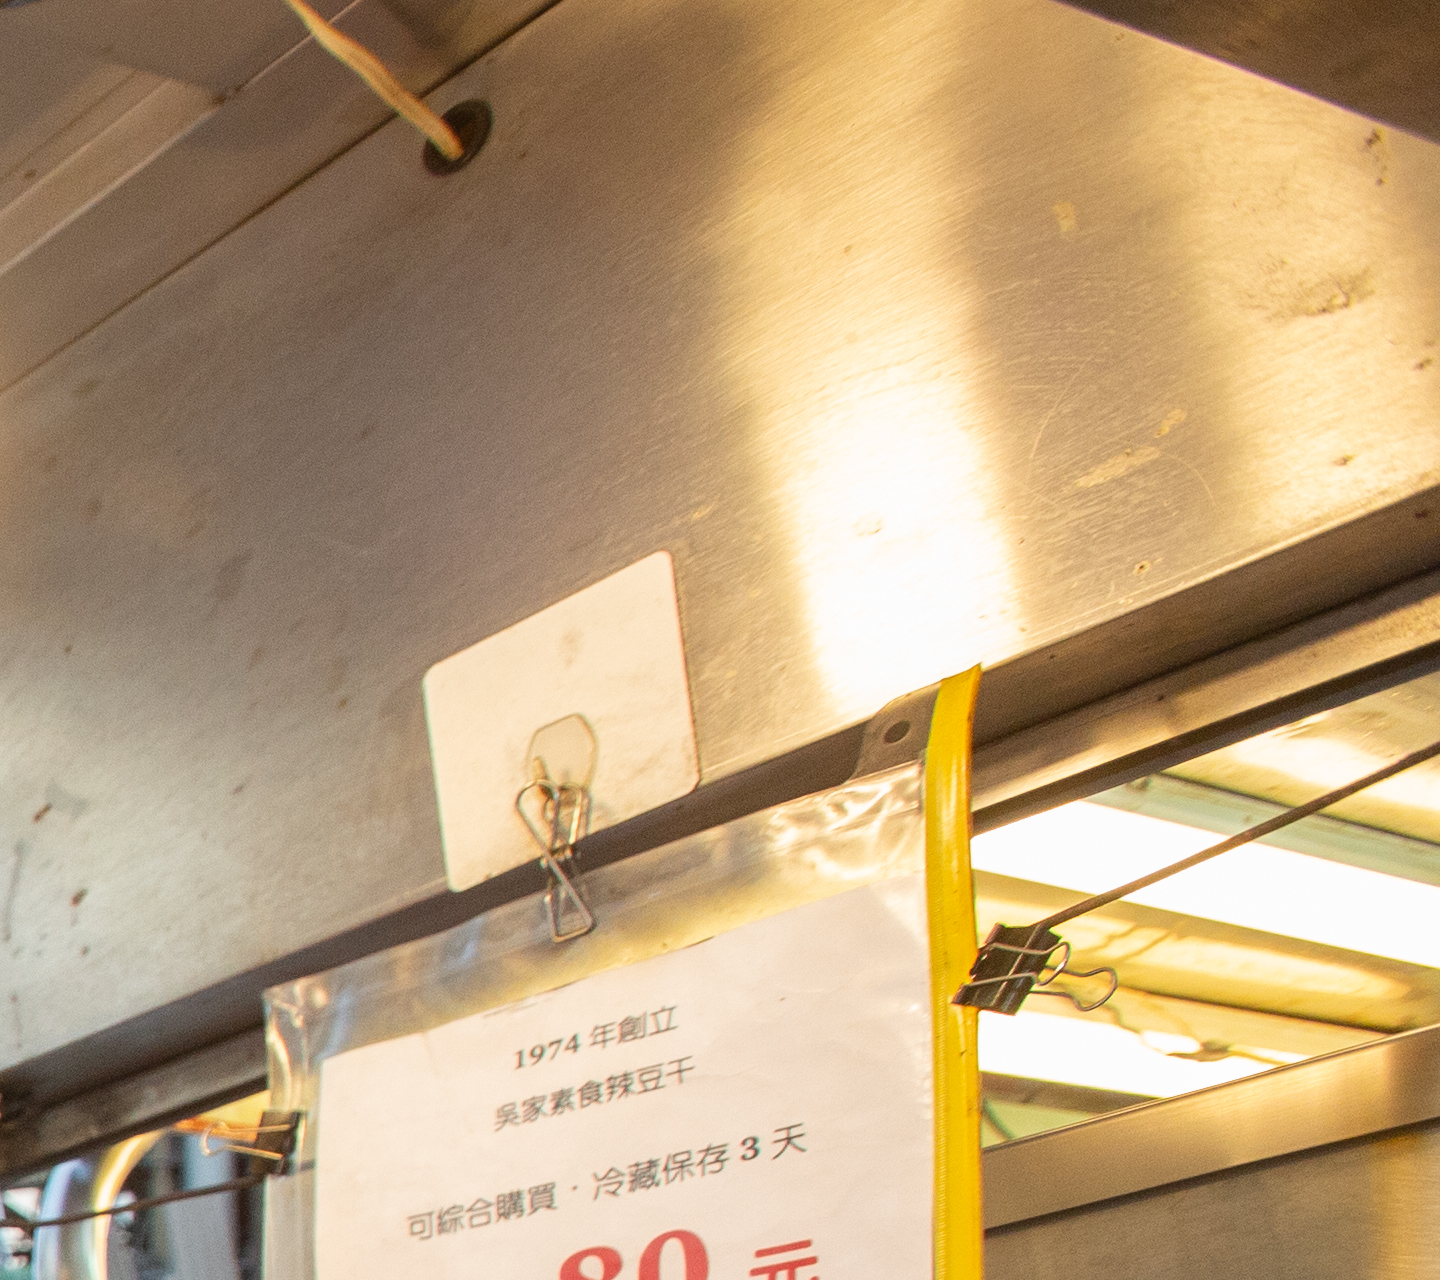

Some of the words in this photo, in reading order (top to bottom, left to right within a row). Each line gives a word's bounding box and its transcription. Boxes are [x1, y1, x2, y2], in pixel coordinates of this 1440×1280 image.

[511, 1031, 582, 1072] 1974
[588, 1004, 680, 1054] 年創立
[738, 1134, 764, 1164] 3
[772, 1122, 808, 1157] 天
